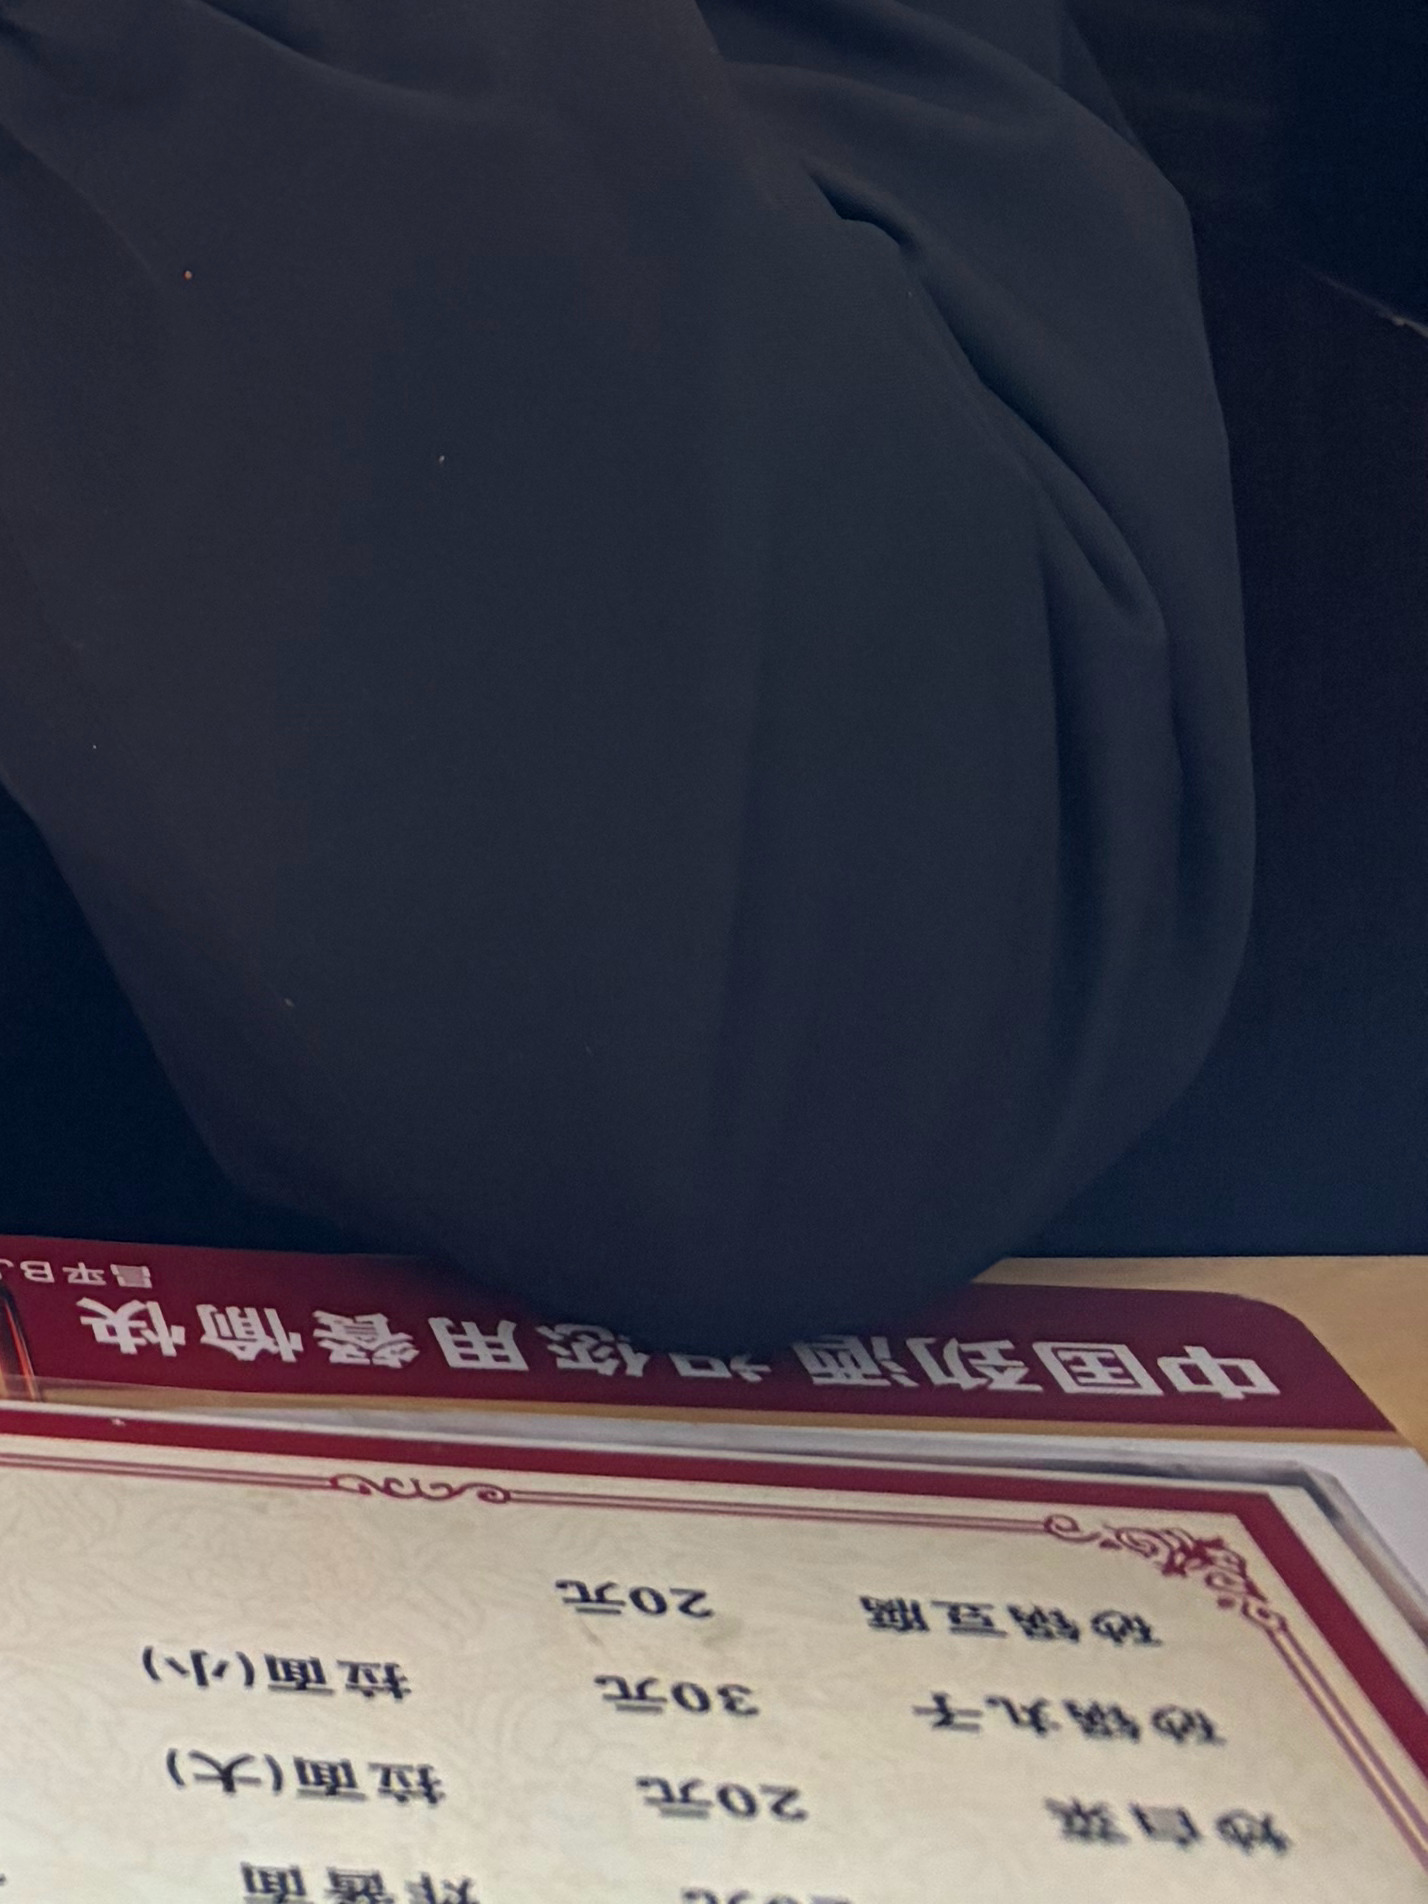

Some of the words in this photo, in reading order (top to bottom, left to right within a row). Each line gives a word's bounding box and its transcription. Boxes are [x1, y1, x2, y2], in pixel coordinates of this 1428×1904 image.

[554, 1579, 715, 1619] 20元
[859, 1596, 1163, 1647] 砂锅豆腐
[594, 1674, 760, 1718] 30元
[914, 1692, 1226, 1747] 砂锅丸子
[635, 1776, 809, 1822] 20元
[1045, 1799, 1291, 1857] 炒白菜
